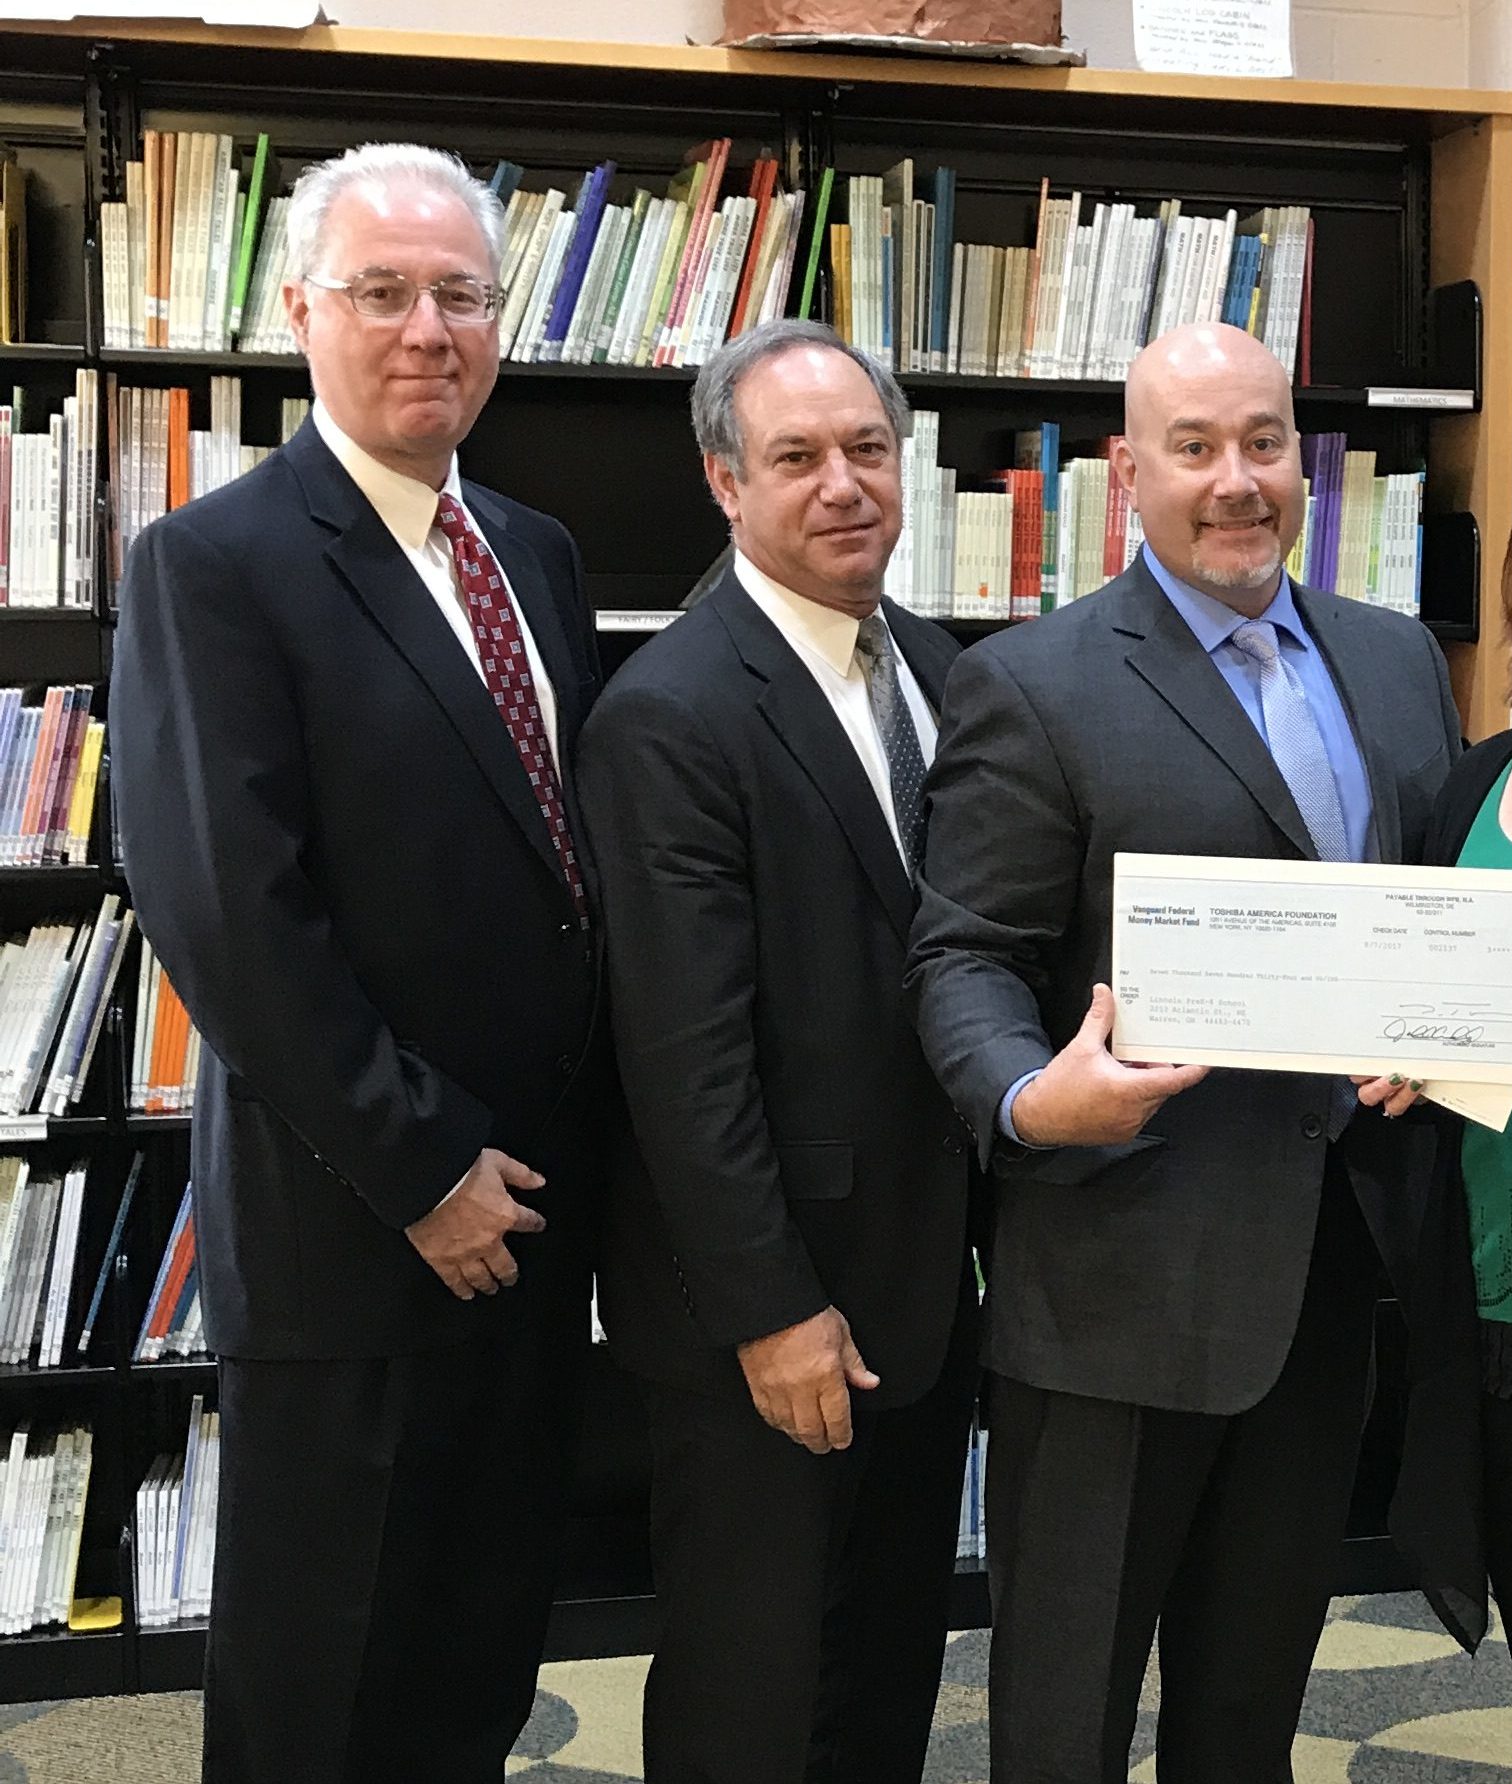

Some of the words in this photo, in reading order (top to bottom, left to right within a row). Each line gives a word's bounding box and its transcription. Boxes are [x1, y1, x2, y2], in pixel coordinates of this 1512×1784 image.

[1393, 397, 1448, 406] MATHEMATICS
[1133, 905, 1167, 915] Vanguard
[1168, 906, 1196, 915] Federal
[1210, 908, 1245, 917] TOSHIBA
[1247, 910, 1284, 918] AMERICA
[1285, 911, 1337, 920] FOUNDATION
[1128, 915, 1153, 926] Money
[1155, 917, 1180, 926] Market
[1183, 918, 1200, 926] Fund
